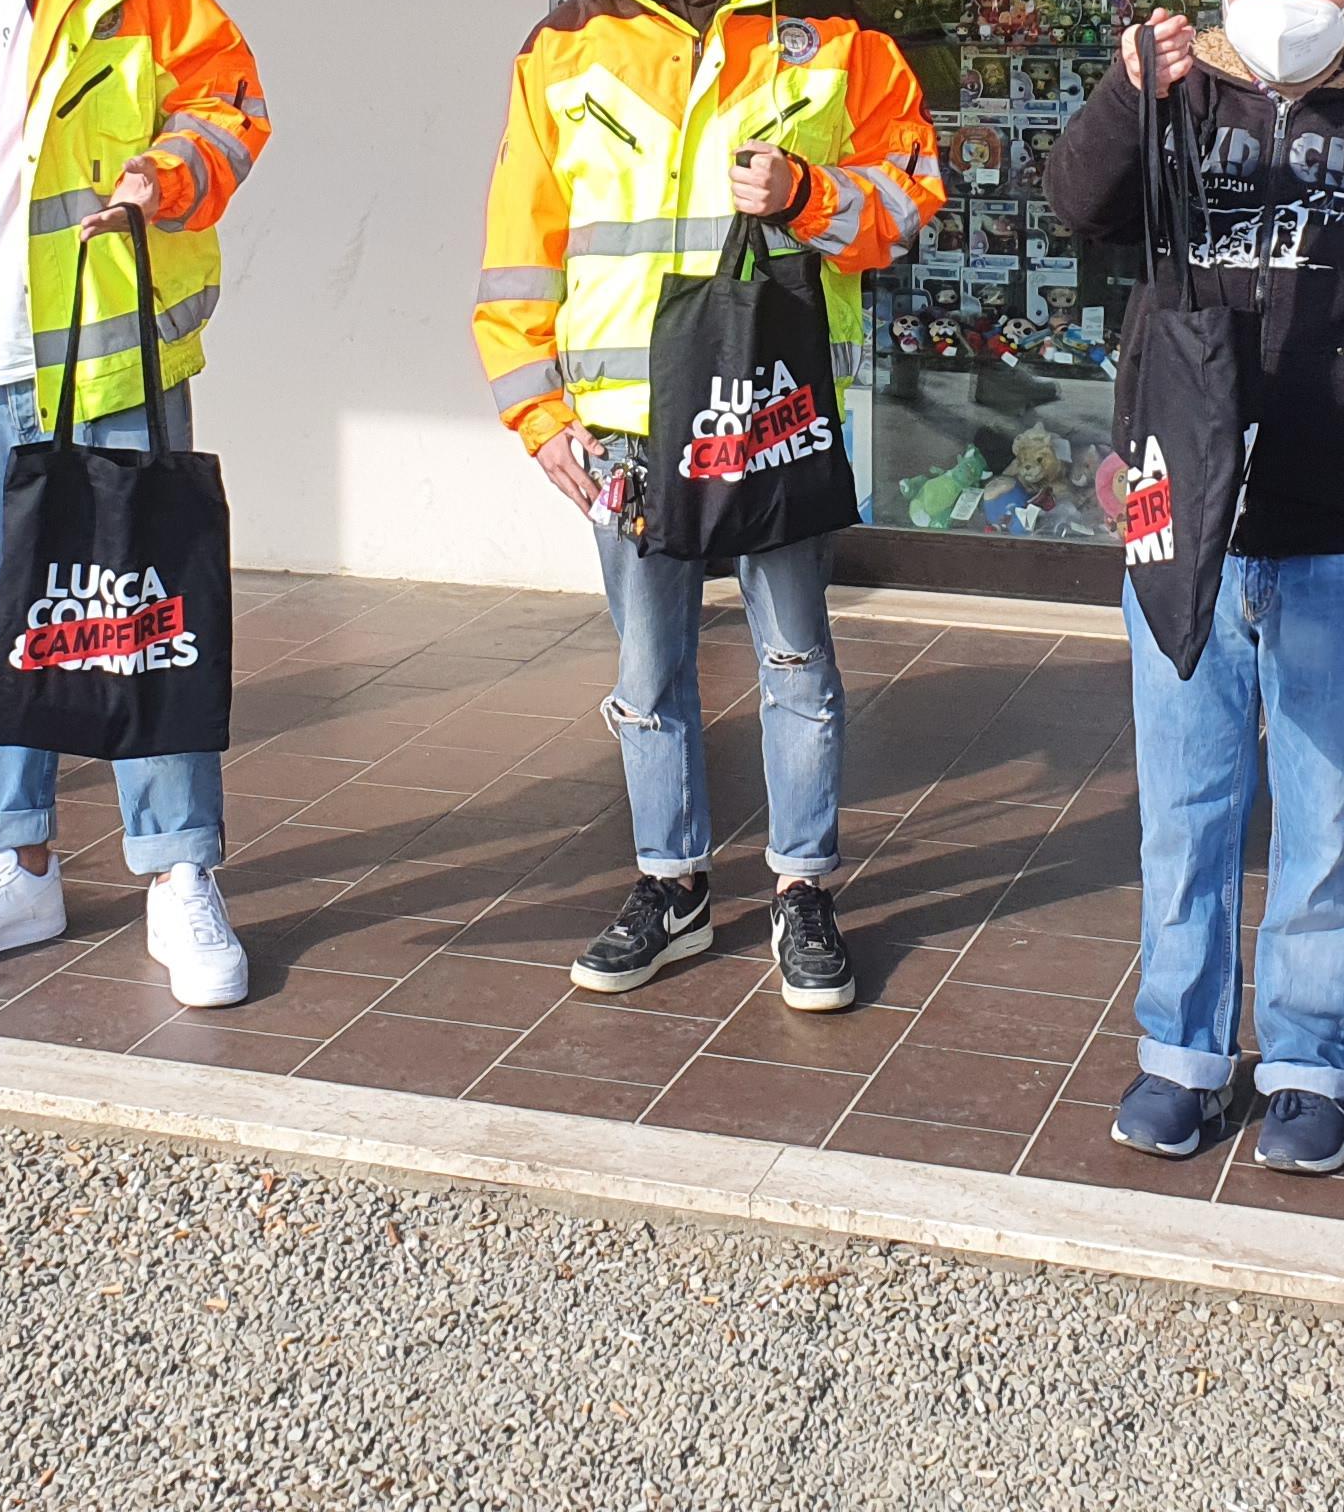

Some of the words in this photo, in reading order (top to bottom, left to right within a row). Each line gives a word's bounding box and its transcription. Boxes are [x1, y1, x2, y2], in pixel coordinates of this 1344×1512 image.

[46, 562, 168, 607] LUCCA
[28, 604, 177, 660] CAMPFIRE
[57, 631, 199, 676] AMES
